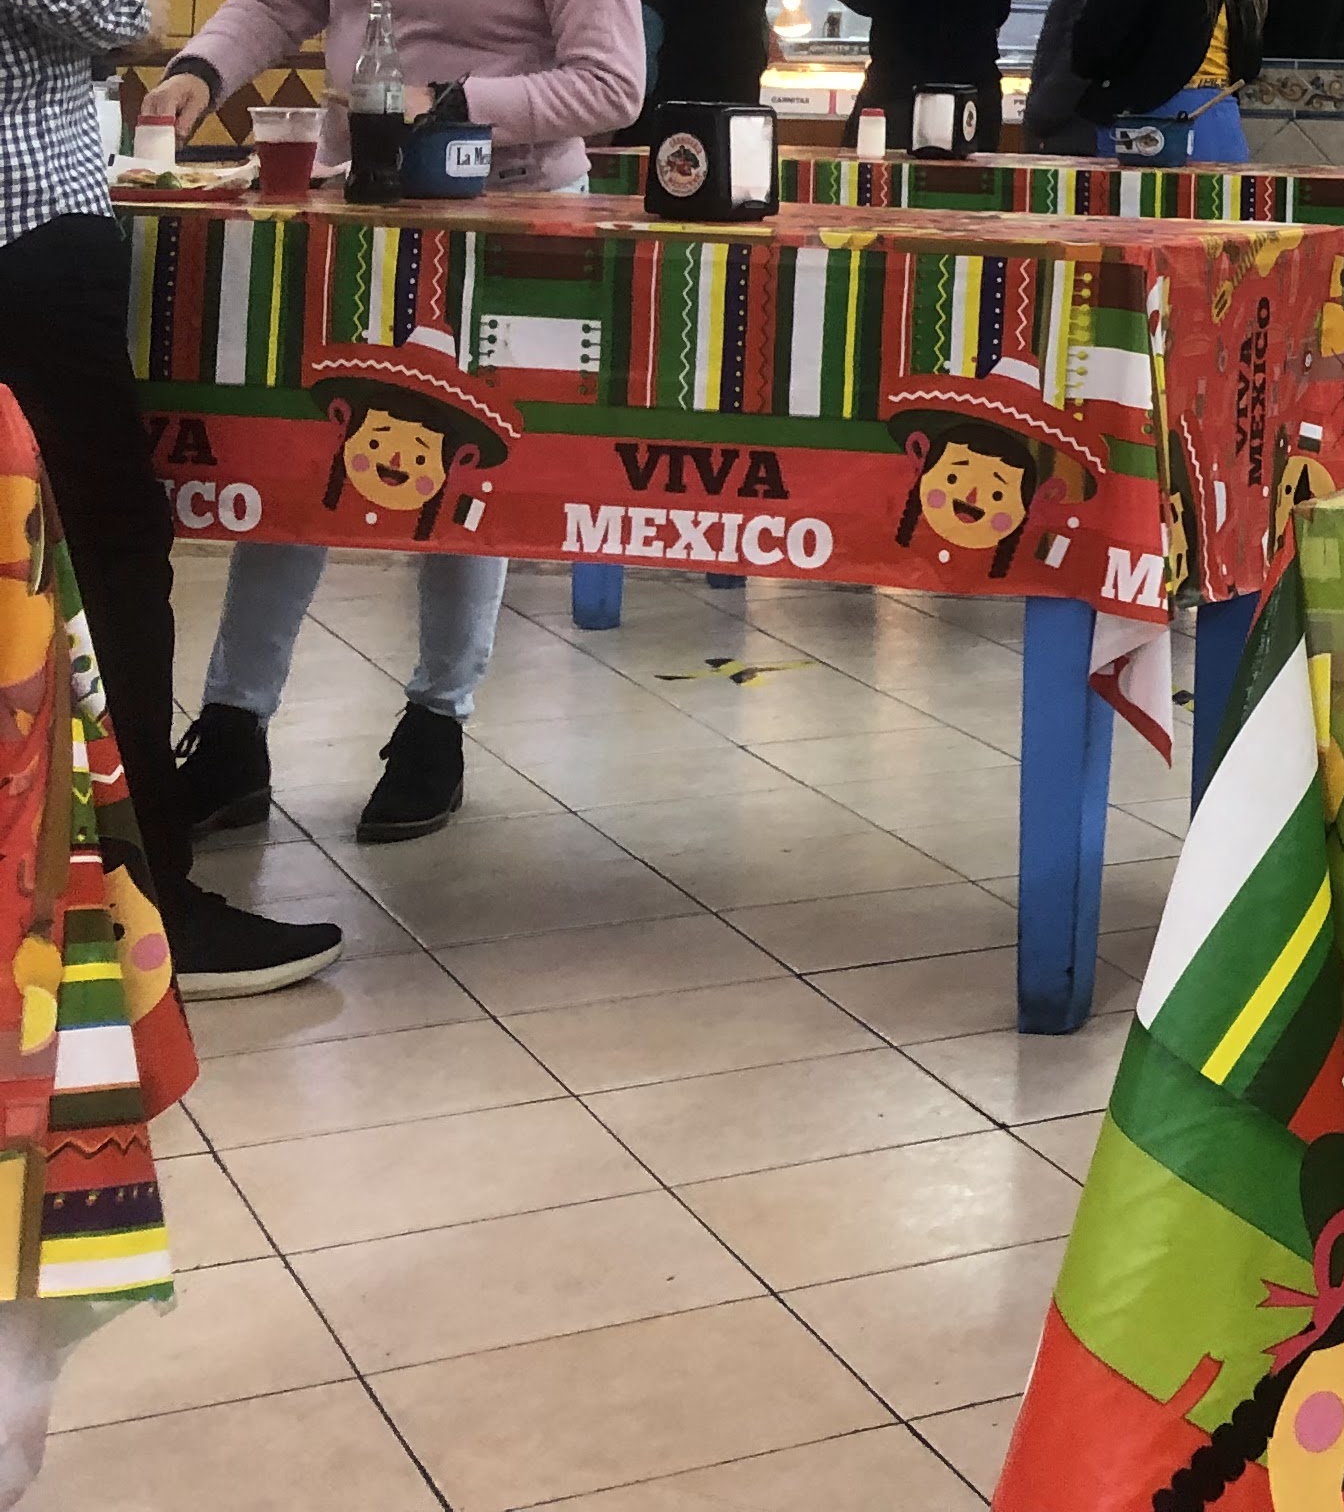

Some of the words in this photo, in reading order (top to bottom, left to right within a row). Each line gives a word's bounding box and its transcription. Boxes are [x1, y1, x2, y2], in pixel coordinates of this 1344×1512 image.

[457, 147, 470, 165] La
[1235, 336, 1253, 458] VIVA
[1247, 296, 1271, 486] MEXICO
[613, 443, 790, 500] VIVA
[560, 502, 834, 570] MEXICO
